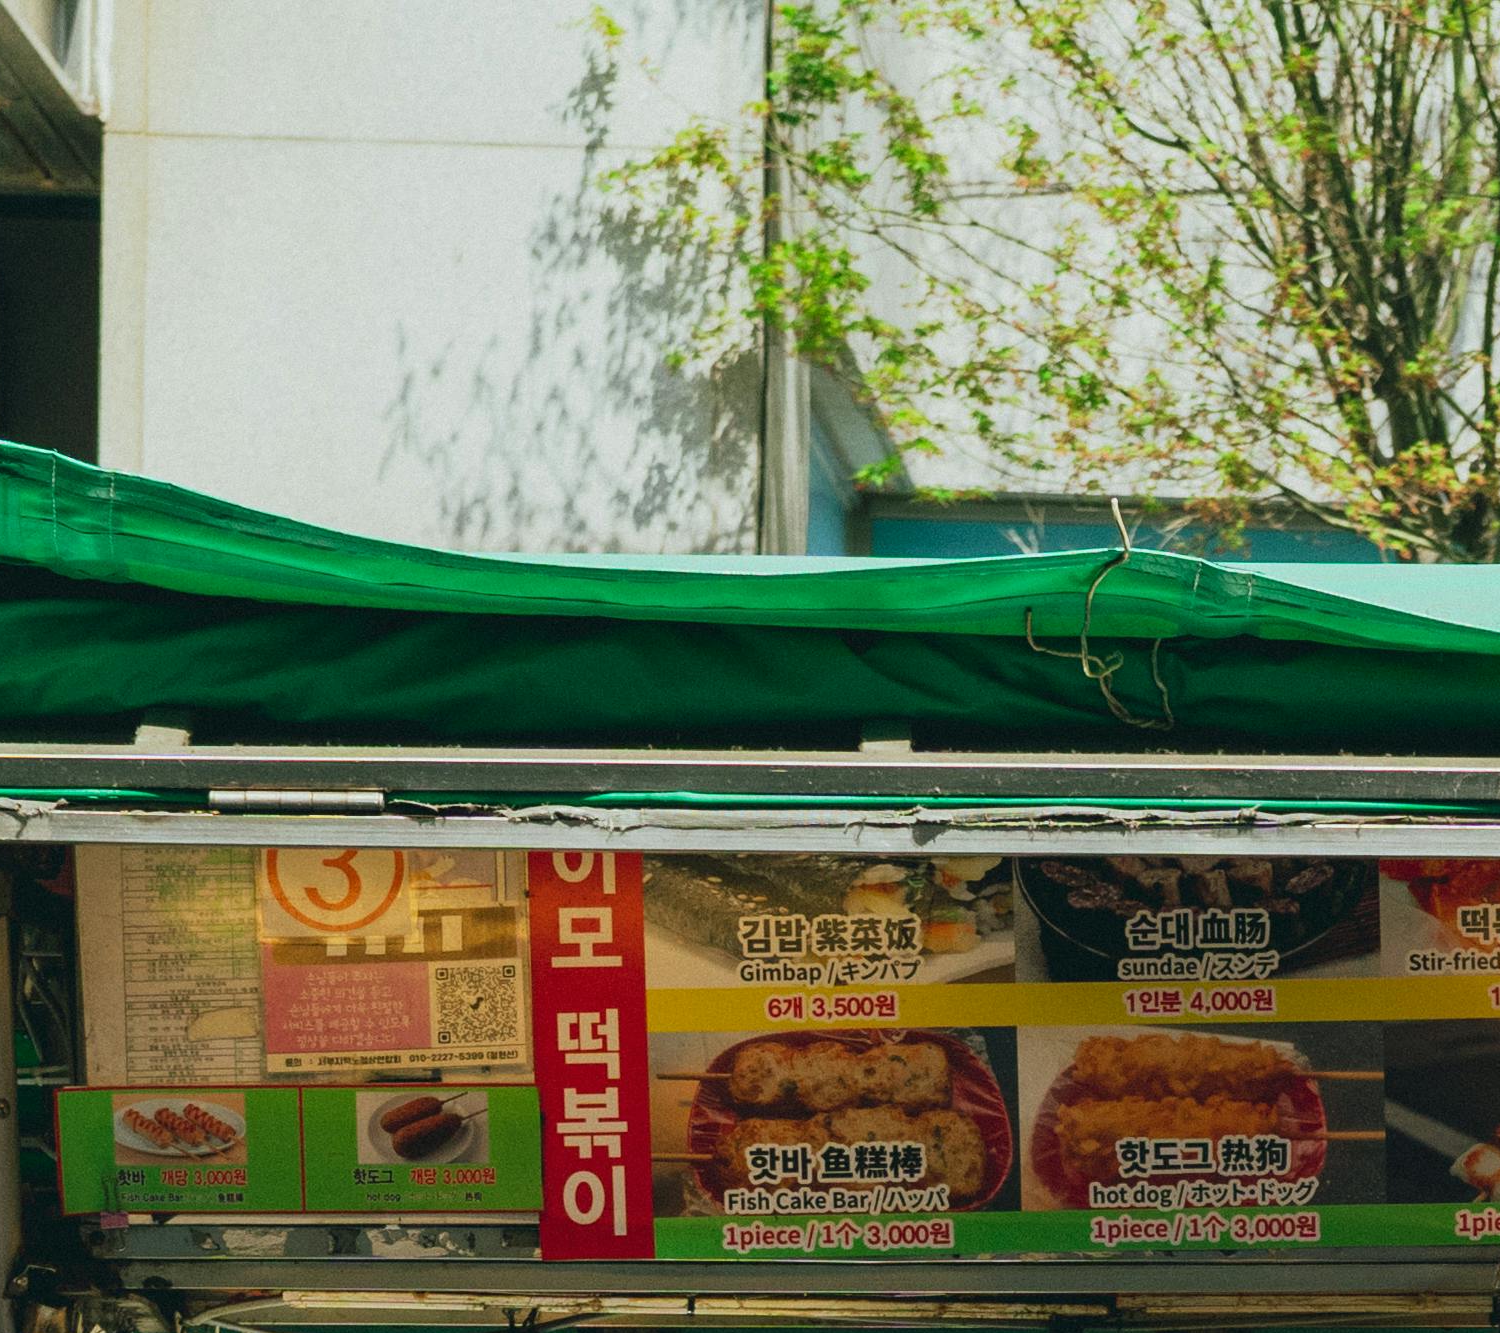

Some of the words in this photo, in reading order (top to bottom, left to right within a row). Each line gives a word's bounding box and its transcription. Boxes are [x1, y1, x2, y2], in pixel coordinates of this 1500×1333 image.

[739, 917, 806, 954] 김밥
[815, 914, 921, 952] 紫菜饭
[1127, 913, 1195, 949] 순대
[1200, 911, 1267, 947] 血肠
[1122, 955, 1197, 977] sundae
[1215, 953, 1278, 976] スンデ
[1409, 947, 1500, 971] Stir-fried
[741, 960, 822, 987] Gimbap
[768, 994, 803, 1020] 6개
[811, 994, 896, 1019] 3,500원
[1126, 991, 1182, 1016] 1인분
[1190, 989, 1275, 1014] 4,000원
[556, 1008, 629, 1236] 떡볶이
[748, 1145, 812, 1183] 핫바
[821, 1143, 924, 1180] 鱼糕棒
[1120, 1139, 1212, 1174] 핫도그
[1221, 1138, 1289, 1171] 热狗
[119, 1169, 148, 1187] 핫바
[160, 1168, 189, 1187] 개당
[353, 1167, 395, 1185] 핫도그
[409, 1167, 438, 1185] 개당
[728, 1190, 768, 1212] Fish
[773, 1190, 822, 1212] Cake
[828, 1189, 866, 1211] Bar
[1094, 1184, 1126, 1205] hot
[1131, 1184, 1172, 1208] dog
[725, 1225, 801, 1250] 1piece
[825, 1222, 859, 1248] 1个
[867, 1222, 952, 1247] 3,000원
[1092, 1219, 1169, 1243] 1piece
[1192, 1217, 1225, 1242] 1个
[1233, 1214, 1319, 1240] 3,000원
